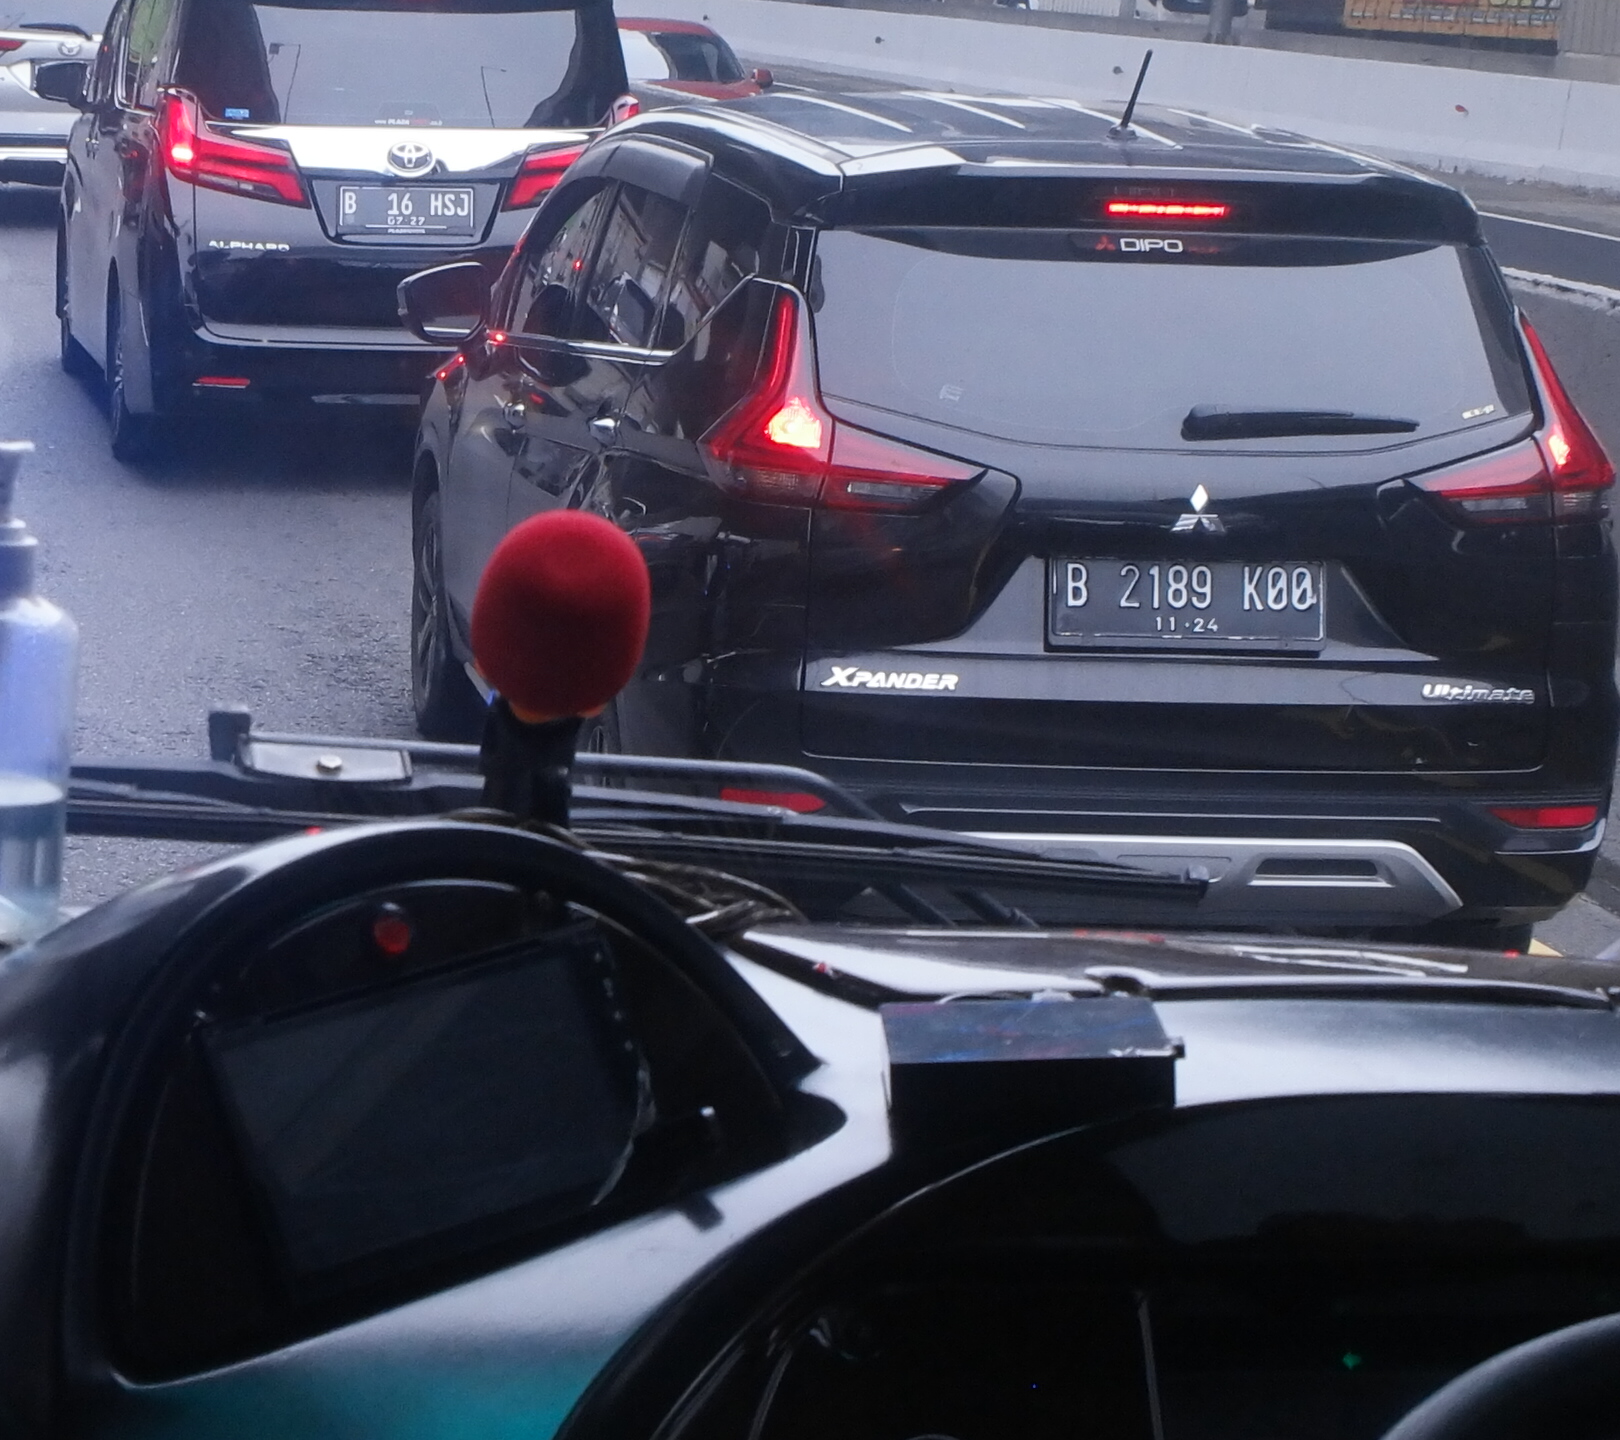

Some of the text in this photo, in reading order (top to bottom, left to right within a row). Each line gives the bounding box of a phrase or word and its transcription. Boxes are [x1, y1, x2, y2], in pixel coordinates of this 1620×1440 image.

[344, 192, 469, 217] B 16 HSJ
[208, 240, 291, 252] ALPHARD
[1119, 238, 1184, 253] DIPO
[1066, 563, 1089, 608] B
[1119, 564, 1212, 609] 2189
[820, 666, 960, 691] XPANDER
[1420, 682, 1536, 704] Ultimate
